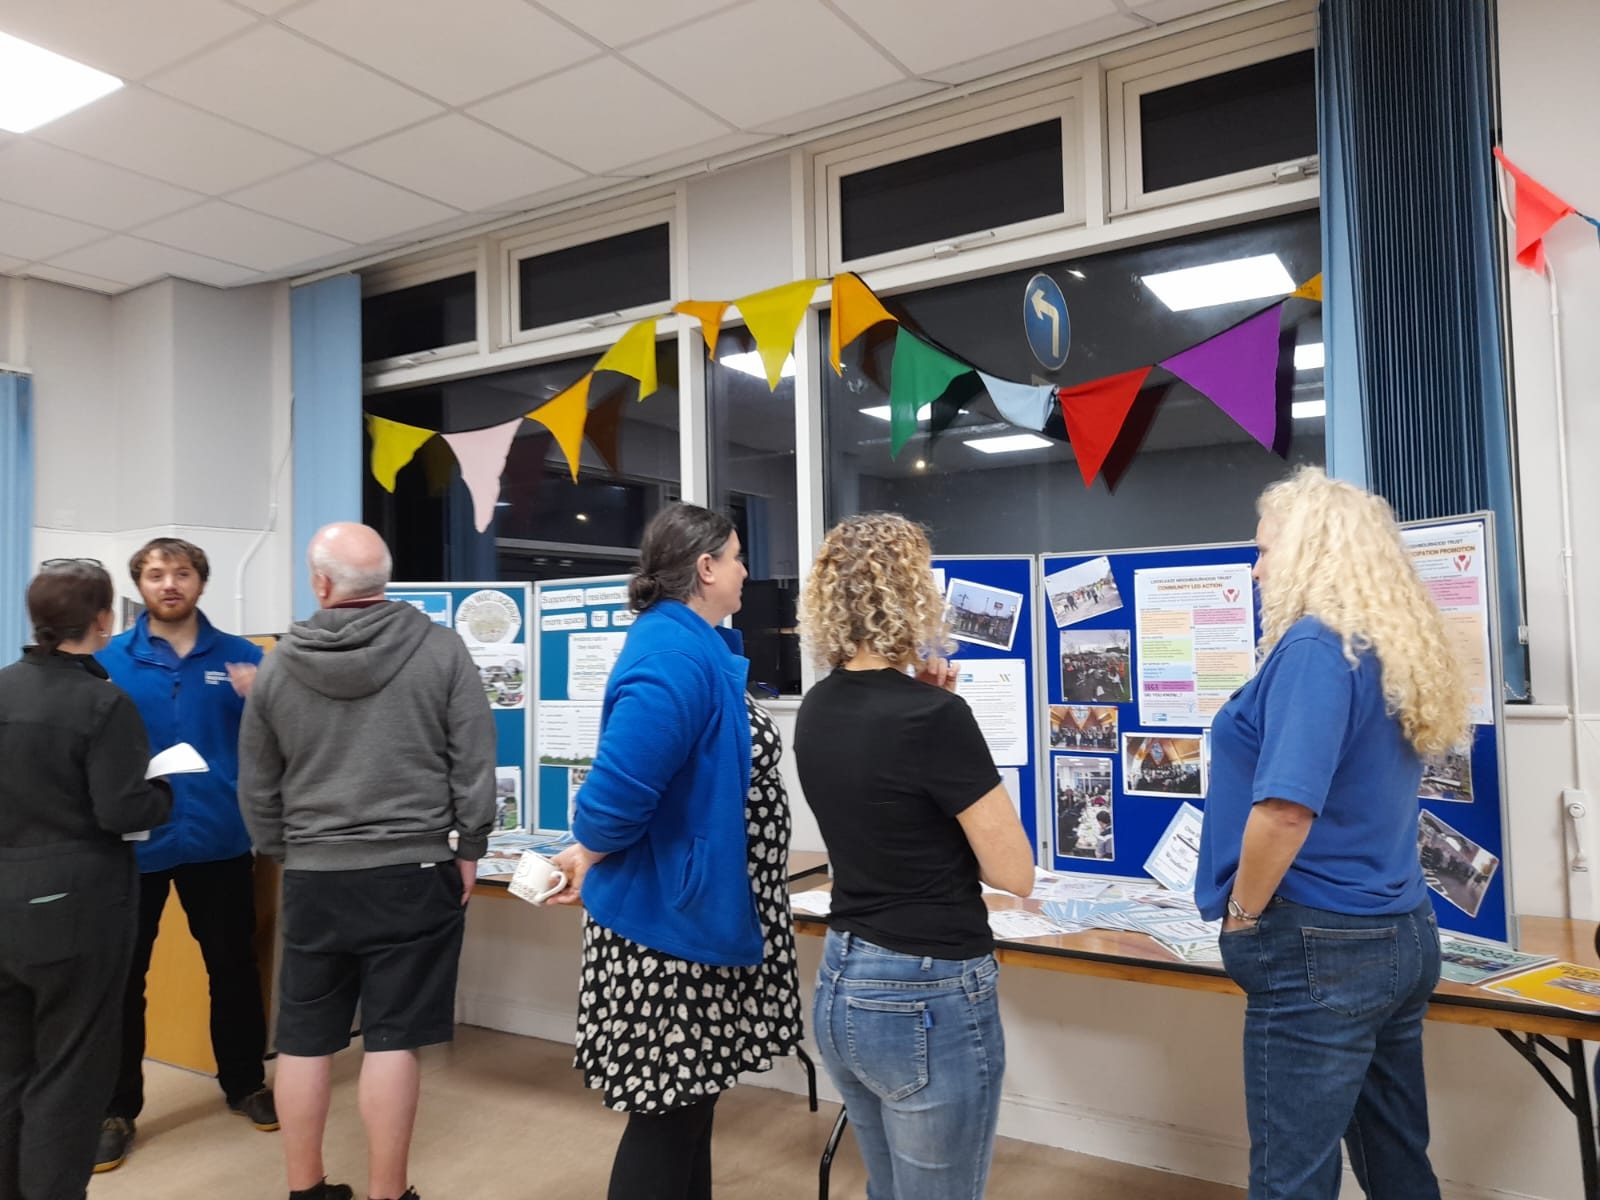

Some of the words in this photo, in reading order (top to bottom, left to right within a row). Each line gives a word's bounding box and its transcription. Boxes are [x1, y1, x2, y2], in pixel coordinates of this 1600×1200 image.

[1412, 549, 1439, 557] CIPATION
[1440, 546, 1476, 555] PROMOTION
[542, 594, 581, 604] Supporting
[587, 592, 621, 601] residents
[563, 616, 585, 627] space
[592, 614, 604, 622] for
